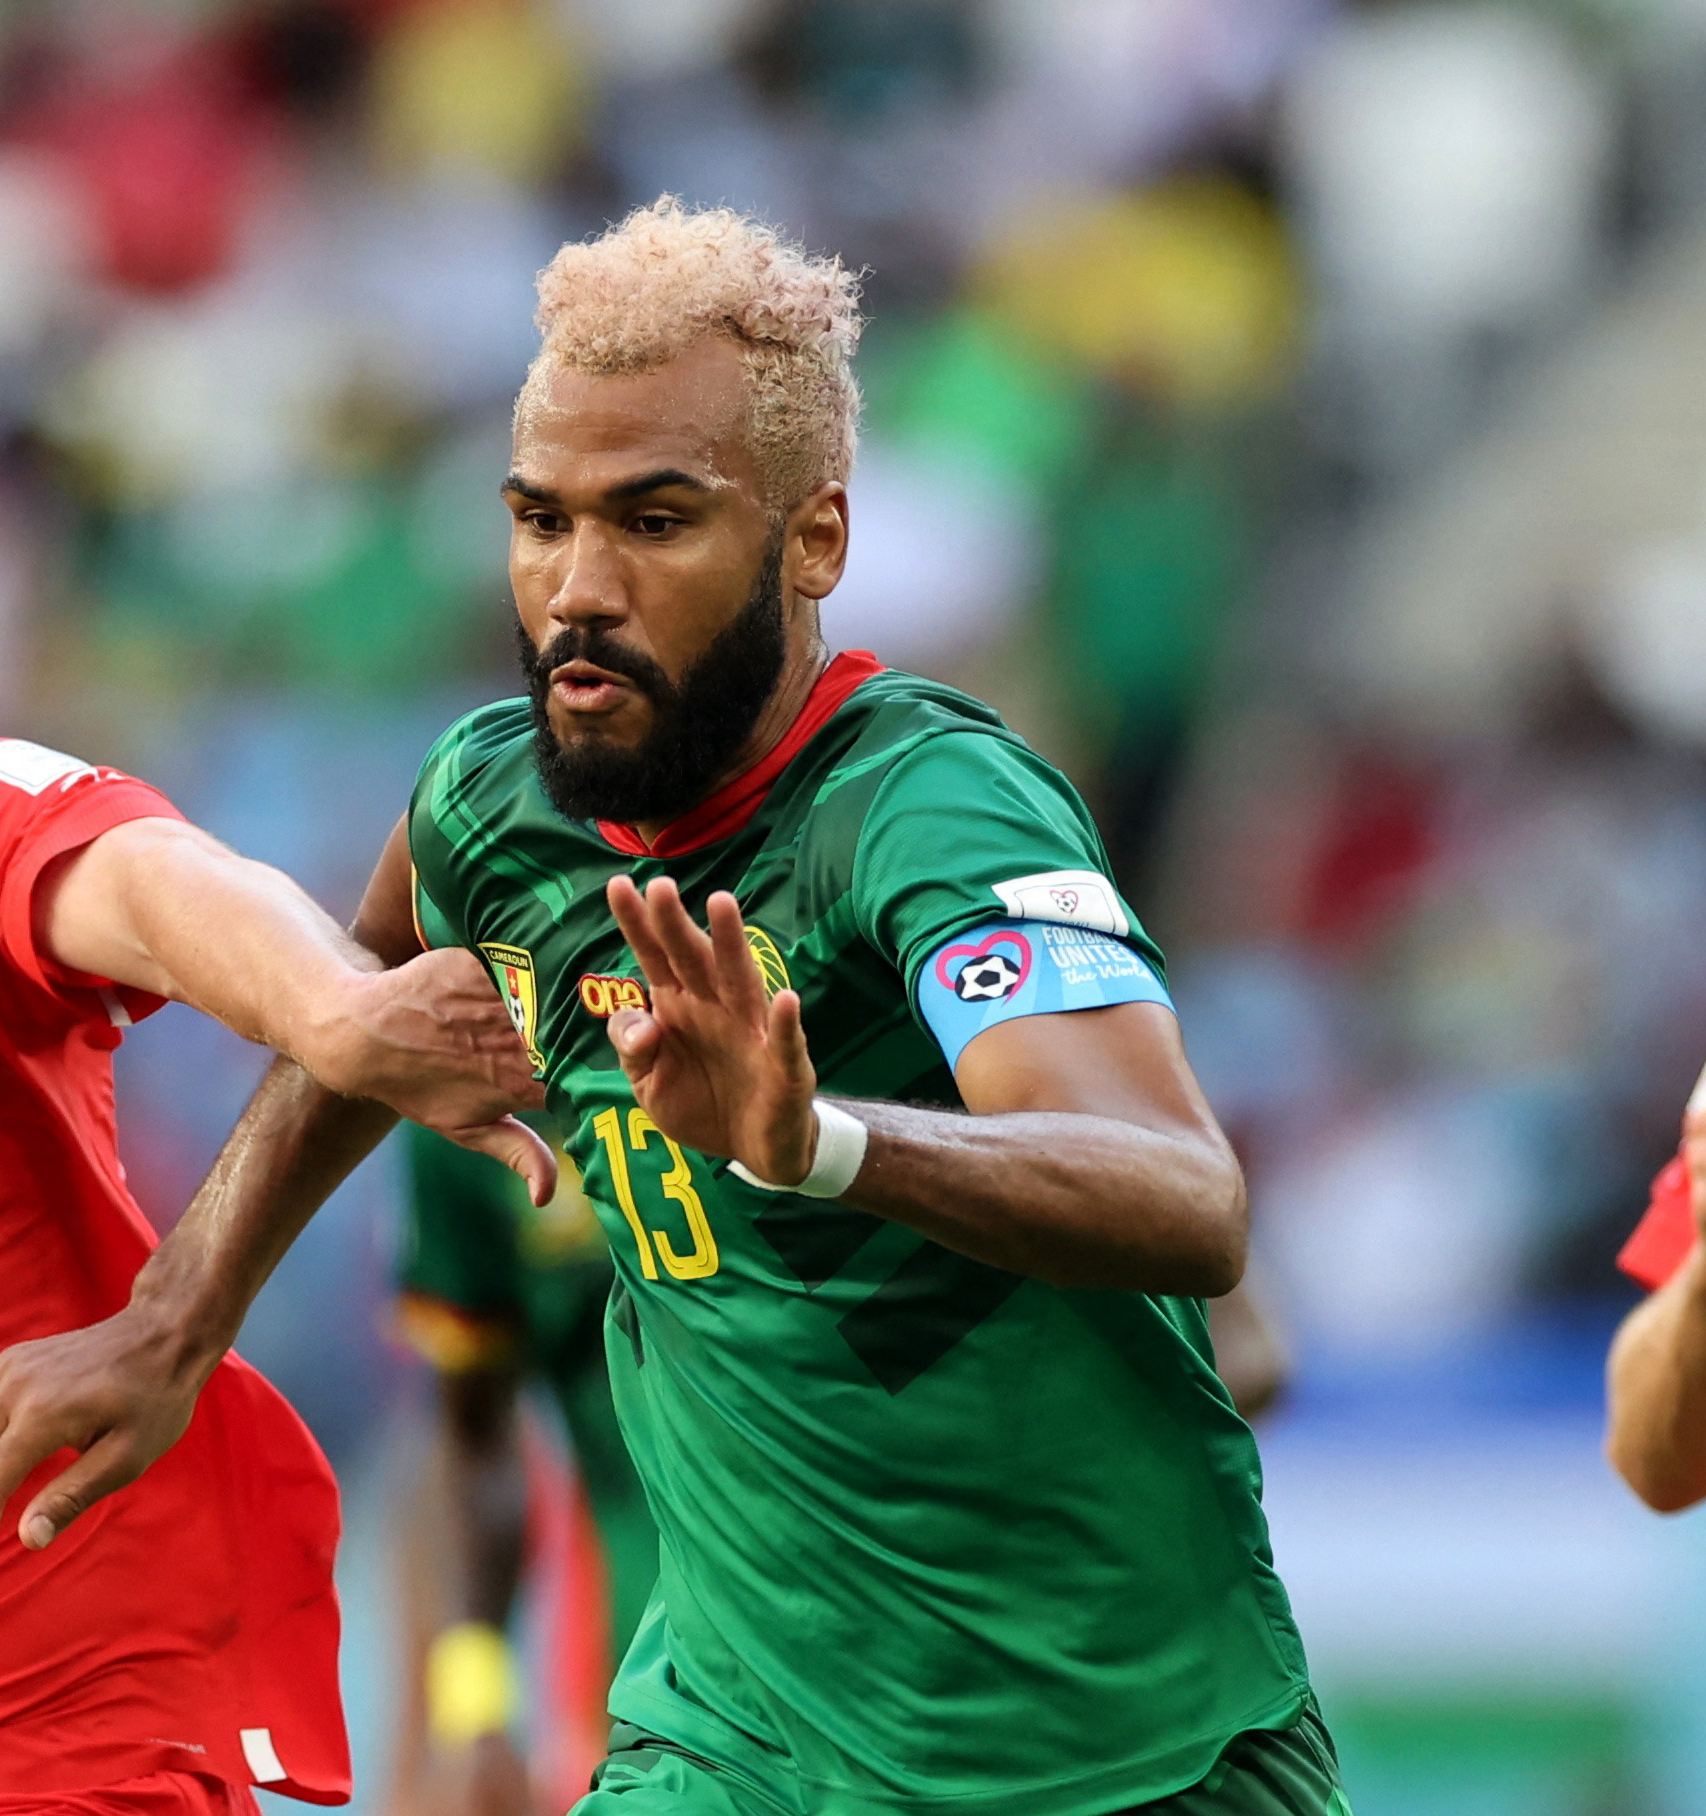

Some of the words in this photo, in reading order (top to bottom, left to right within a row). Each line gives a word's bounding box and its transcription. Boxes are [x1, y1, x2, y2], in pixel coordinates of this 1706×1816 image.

[489, 950, 529, 968] CAMEROUN
[1048, 944, 1138, 969] UNITES
[1062, 967, 1098, 985] the
[581, 977, 645, 1016] one
[592, 1105, 720, 1281] 13
